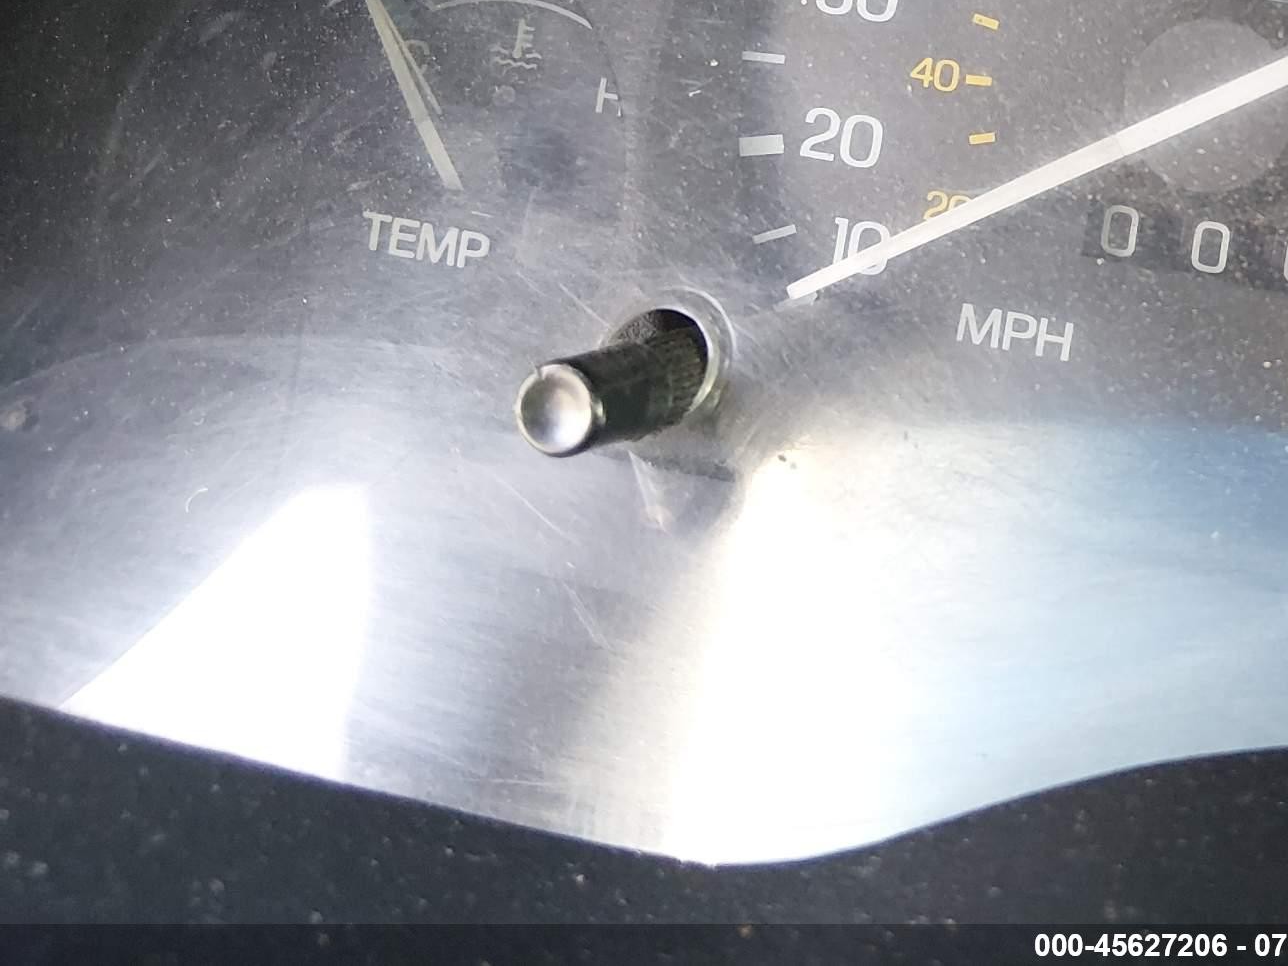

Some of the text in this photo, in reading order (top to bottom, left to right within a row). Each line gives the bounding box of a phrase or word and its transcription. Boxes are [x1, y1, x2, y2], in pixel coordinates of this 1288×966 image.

[910, 57, 961, 93] 40
[799, 107, 884, 169] 20
[362, 210, 491, 269] TEMP
[955, 302, 1075, 362] MPH
